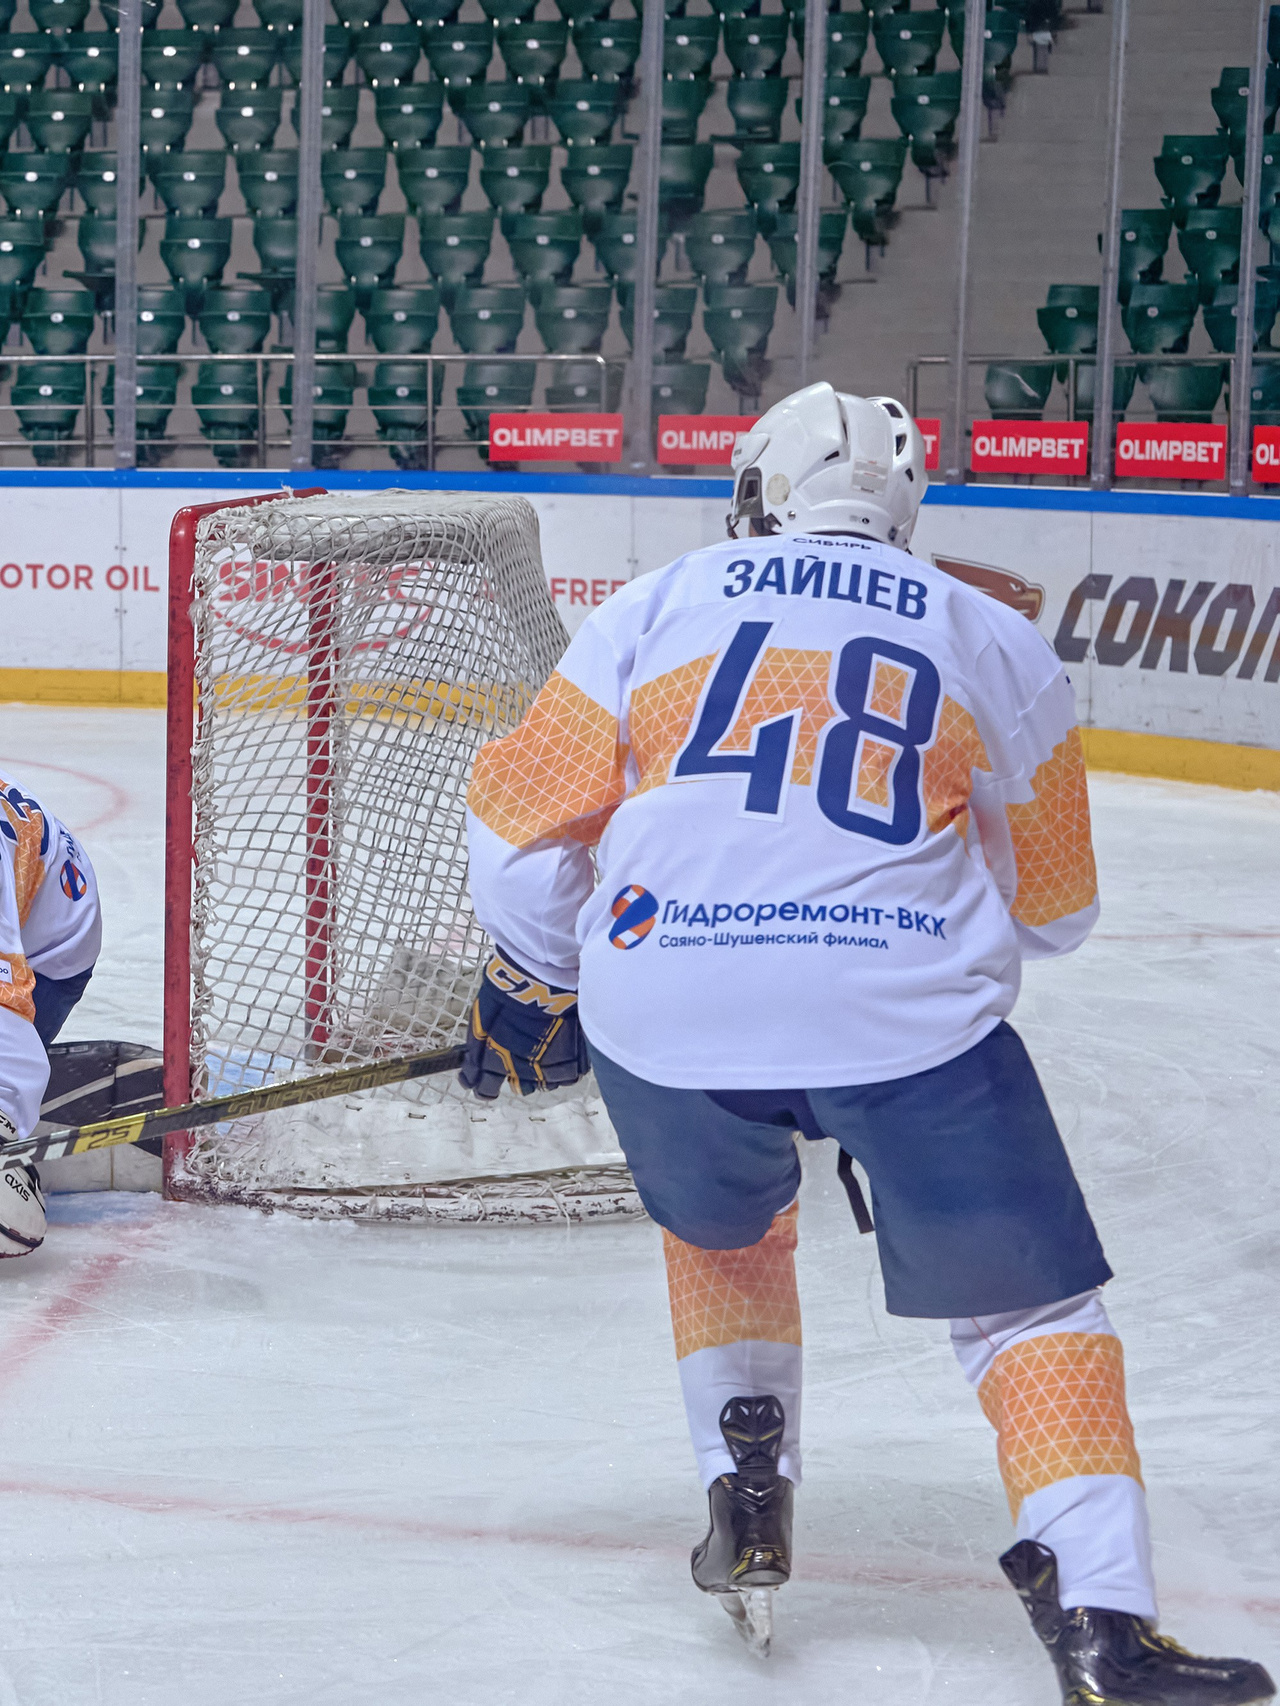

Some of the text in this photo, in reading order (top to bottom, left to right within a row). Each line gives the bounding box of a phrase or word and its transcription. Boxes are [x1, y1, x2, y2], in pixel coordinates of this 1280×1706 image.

[493, 427, 619, 448] OLIMPBET
[661, 430, 737, 452] OLIMP
[974, 436, 1084, 459] OLIMPBET
[1119, 439, 1223, 463] OLIMPBET
[793, 537, 872, 550] СИБИРЬ
[106, 565, 160, 592] OIL
[723, 555, 928, 620] ЗАЙЦЕВ
[674, 621, 941, 846] 48
[659, 931, 889, 949] Саяно-Шушенский филиал
